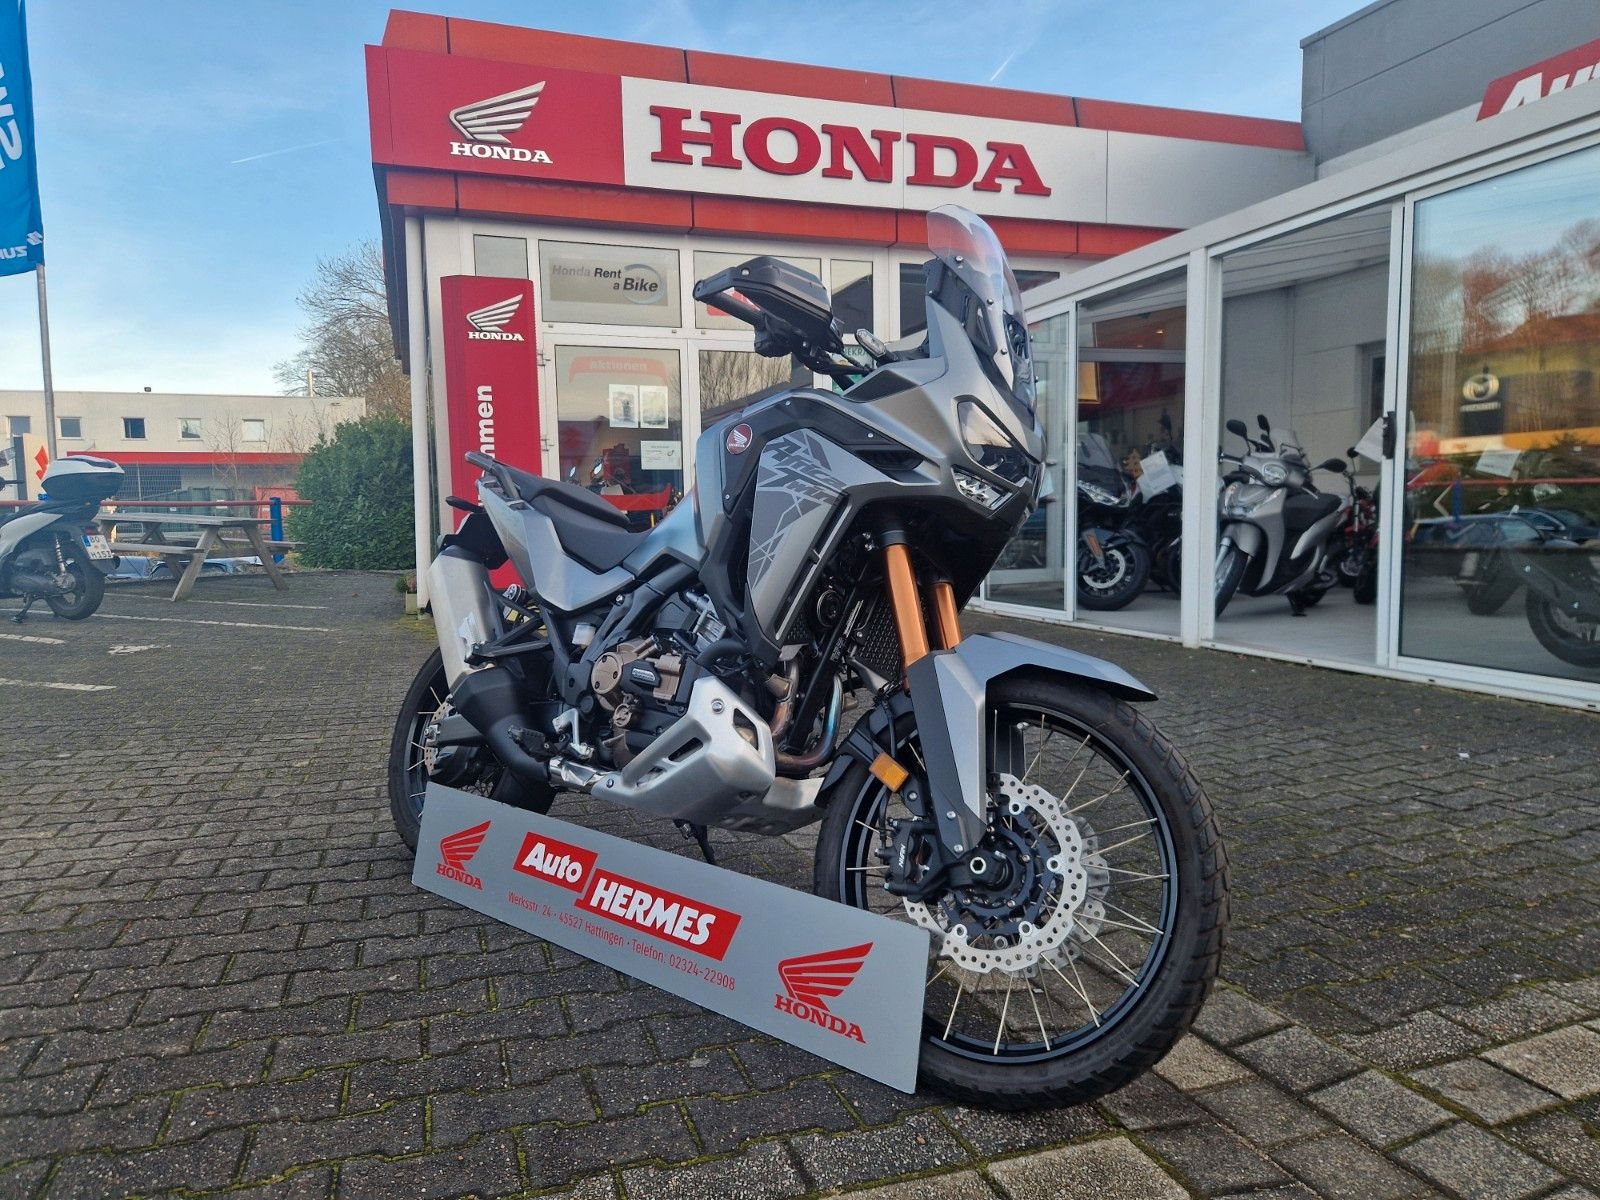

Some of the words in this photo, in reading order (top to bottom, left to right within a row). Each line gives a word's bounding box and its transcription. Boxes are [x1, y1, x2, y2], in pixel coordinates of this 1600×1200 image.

[449, 142, 553, 164] HONDA
[650, 105, 1052, 197] HONDA
[552, 264, 591, 277] Honda
[594, 267, 622, 279] Rent
[613, 281, 620, 291] a
[623, 277, 658, 292] Bike
[468, 331, 524, 342] HONDA
[436, 863, 484, 891] HONDA
[522, 842, 583, 884] Auto
[590, 877, 716, 945] HERMES
[542, 904, 552, 918] 24
[558, 912, 582, 931] 45527
[585, 921, 625, 948] Hattingen
[632, 938, 667, 965] Telefon:
[669, 954, 736, 991] 02324-22908
[774, 993, 867, 1044] HONDA
